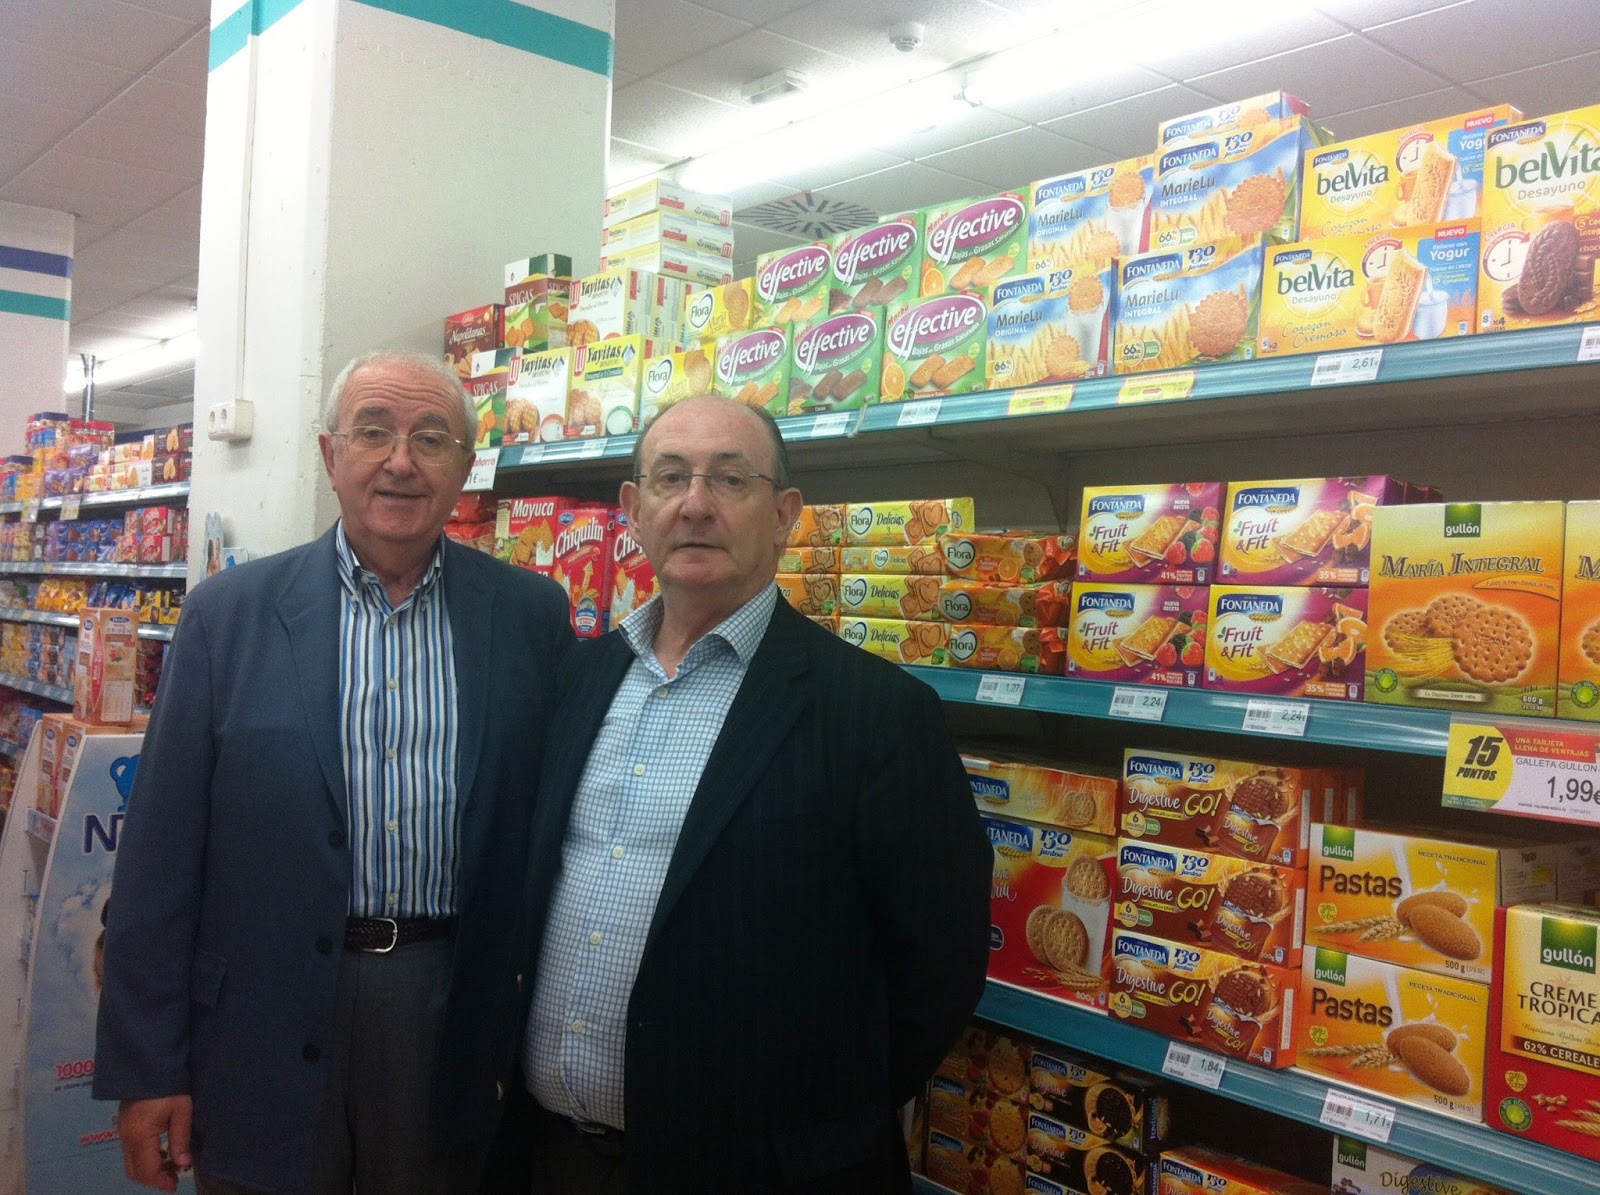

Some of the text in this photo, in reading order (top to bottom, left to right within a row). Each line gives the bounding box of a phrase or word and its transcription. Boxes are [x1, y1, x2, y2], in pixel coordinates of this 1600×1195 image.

[1166, 118, 1212, 139] FONTANEDA
[1466, 116, 1493, 128] NUEVO
[1224, 131, 1253, 150] 130
[1490, 125, 1544, 143] FONTANEDA
[1163, 147, 1217, 169] FONTANEDA
[1314, 152, 1348, 164] FONTANEDA
[1090, 167, 1114, 185] 130
[1317, 154, 1389, 195] belVita
[1038, 181, 1084, 200] FONTANEDA
[1161, 175, 1216, 197] MarieLu
[1518, 181, 1586, 200] Desayuno
[1160, 194, 1198, 208] INTEGRAL
[1331, 190, 1372, 204] Desayuno
[1038, 208, 1085, 227] MarieLu
[933, 207, 1016, 267] effective
[1437, 228, 1465, 238] NUEVO
[838, 232, 910, 287] effective
[1188, 245, 1216, 264] 130
[1276, 252, 1310, 262] FONTANEDA
[1430, 248, 1470, 261] Yogur
[1126, 260, 1180, 278] FONTANEDA
[1277, 257, 1355, 295] belVita
[762, 254, 826, 304] effective
[1049, 270, 1072, 287] 130
[581, 277, 610, 298] Yayitas
[997, 282, 1042, 299] FONTANEDA
[509, 288, 533, 305] SPIGAS
[1124, 289, 1179, 308] MarieLu
[1292, 293, 1336, 304] Desayuno
[691, 305, 710, 318] Flora
[996, 310, 1044, 328] MarieLu
[1124, 307, 1161, 318] INTEGRAL
[450, 326, 486, 344] Napolitanas
[893, 306, 977, 365] effective
[995, 327, 1028, 336] ORIGINAL
[588, 345, 622, 365] Yayitas
[800, 324, 870, 377] effective
[520, 357, 552, 375] Yayitas
[721, 340, 781, 387] effective
[648, 371, 668, 383] Flora
[473, 381, 498, 396] SPIGAS
[1092, 500, 1142, 510] FONTANEDA
[1238, 494, 1295, 504] FONTANEDA
[512, 500, 554, 522] Mayuca
[877, 513, 904, 526] Delicias
[851, 516, 870, 526] Flora
[1445, 523, 1480, 536] gullón
[947, 546, 972, 560] Flora
[1161, 571, 1176, 580] 41%
[1319, 571, 1336, 579] 35%
[844, 585, 864, 597] Flora
[870, 585, 899, 599] Delicias
[944, 600, 969, 612] Flora
[1082, 597, 1132, 608] FONTANEDA
[1221, 599, 1279, 611] FONTANEDA
[844, 629, 864, 640] Flora
[870, 628, 900, 644] Delicias
[950, 638, 974, 651] Flora
[1306, 684, 1324, 693] 35%
[1464, 736, 1503, 767] 15
[1533, 739, 1564, 747] TARJETA
[1552, 748, 1589, 757] VENTAJAS
[1130, 761, 1180, 777] FONTANEDA
[1189, 762, 1215, 777] 130
[1516, 757, 1597, 773] GALLETA GULLON
[1457, 767, 1497, 781] PUNTOS
[1129, 787, 1181, 812] Digestive
[1184, 793, 1222, 817] GO!
[1132, 814, 1139, 822] 6
[1223, 817, 1259, 844] Digestive
[1040, 829, 1072, 850] 130
[1124, 850, 1174, 869] FONTANEDA
[1324, 846, 1352, 857] gullón
[1418, 851, 1487, 865] RECETA TRADICIONAL
[1182, 855, 1209, 870] 130
[1320, 865, 1402, 899] Pastas
[1122, 877, 1215, 911] Digestive GO!
[1125, 904, 1132, 913] 6
[1215, 912, 1251, 941] Digestive
[1118, 940, 1167, 962] FONTANEDA
[1174, 948, 1200, 965] 130
[1543, 948, 1594, 968] gullón
[1445, 960, 1465, 973] 500 g
[1316, 968, 1344, 983] gullón
[1116, 966, 1207, 1006] Digestive GO!
[1409, 981, 1478, 1003] RECETA TRADICIONAL
[1119, 994, 1126, 1003] 6
[1530, 981, 1597, 1009] CREME
[1311, 988, 1393, 1027] Pastas
[1206, 1009, 1240, 1038] Digestive
[1523, 1040, 1547, 1056] 62%
[1033, 1055, 1067, 1076] FONTANEDA
[1434, 1095, 1454, 1109] 500 g
[1031, 1118, 1065, 1139] FONTANEDA
[1338, 1153, 1365, 1168] gullón
[1163, 1162, 1202, 1184] FONTANEDA
[1207, 1174, 1227, 1186] 130
[1380, 1171, 1462, 1195] Digestive
